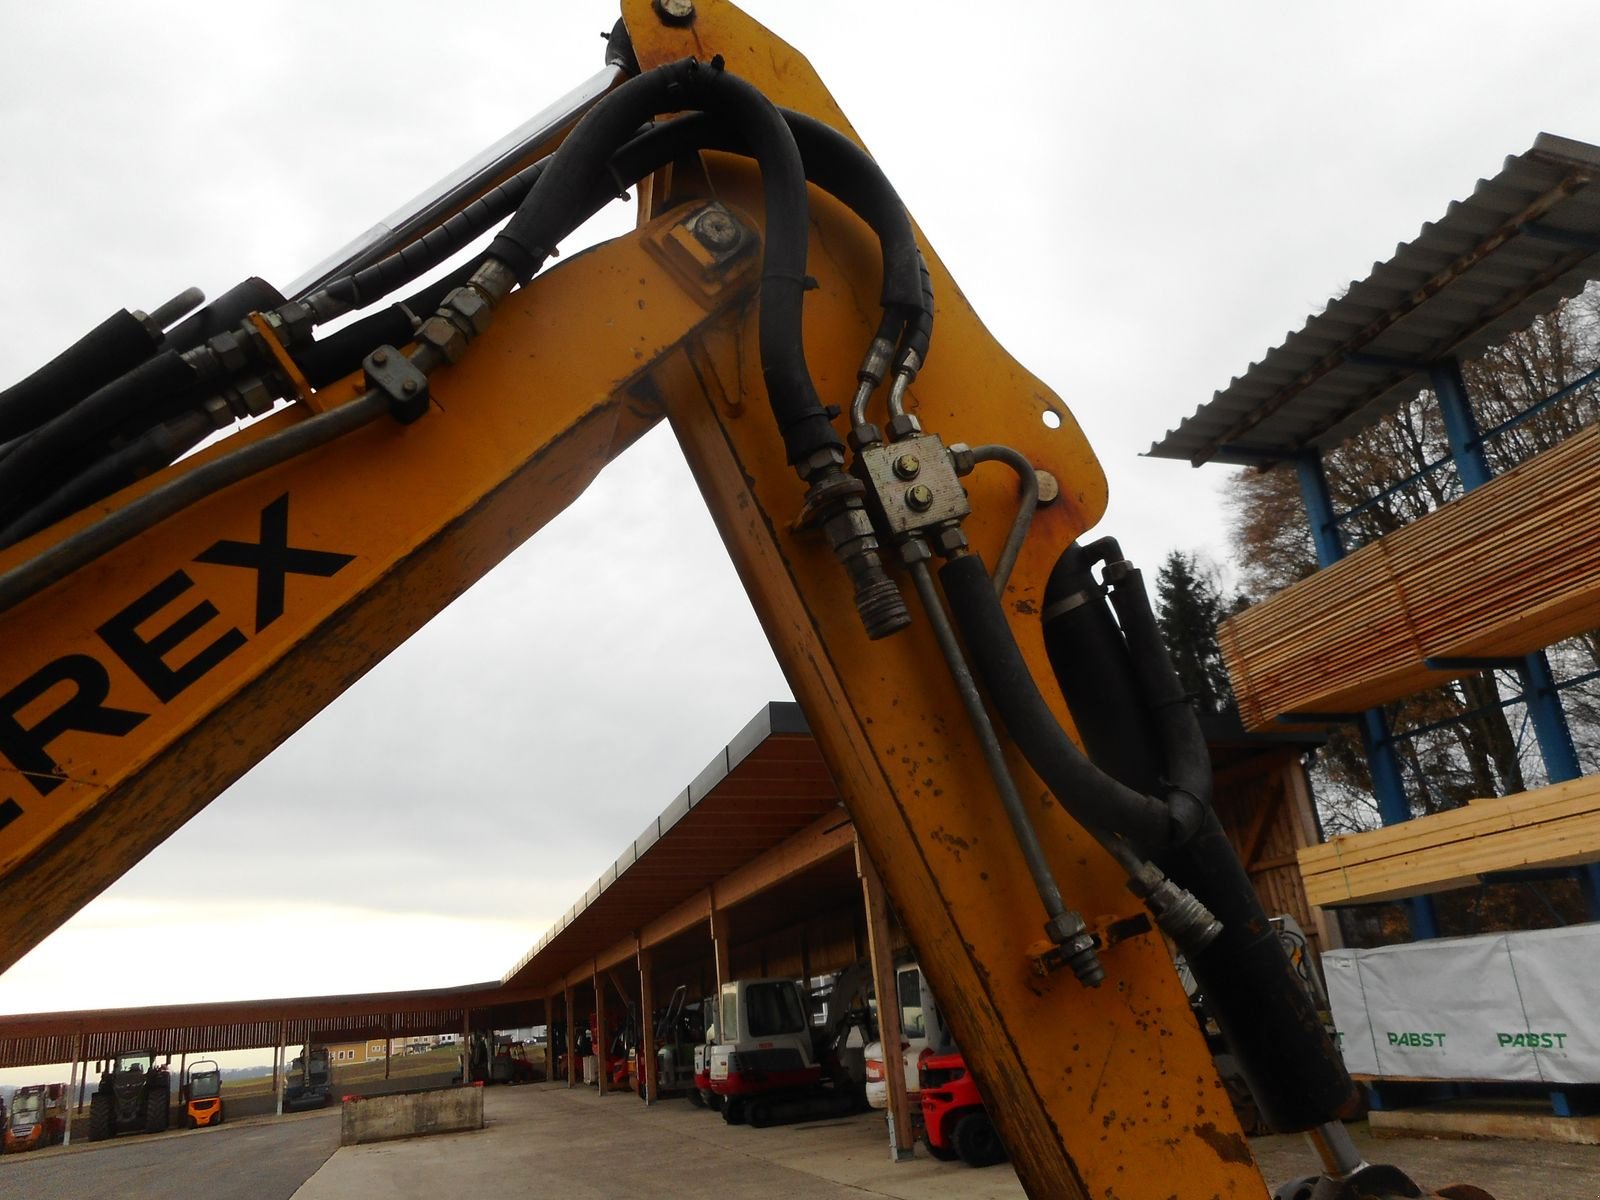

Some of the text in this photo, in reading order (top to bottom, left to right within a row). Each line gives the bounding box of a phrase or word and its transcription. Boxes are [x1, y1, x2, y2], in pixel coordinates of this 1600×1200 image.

[0, 491, 358, 831] REX
[1387, 1032, 1446, 1047] PABST
[1497, 1033, 1567, 1048] PABST
